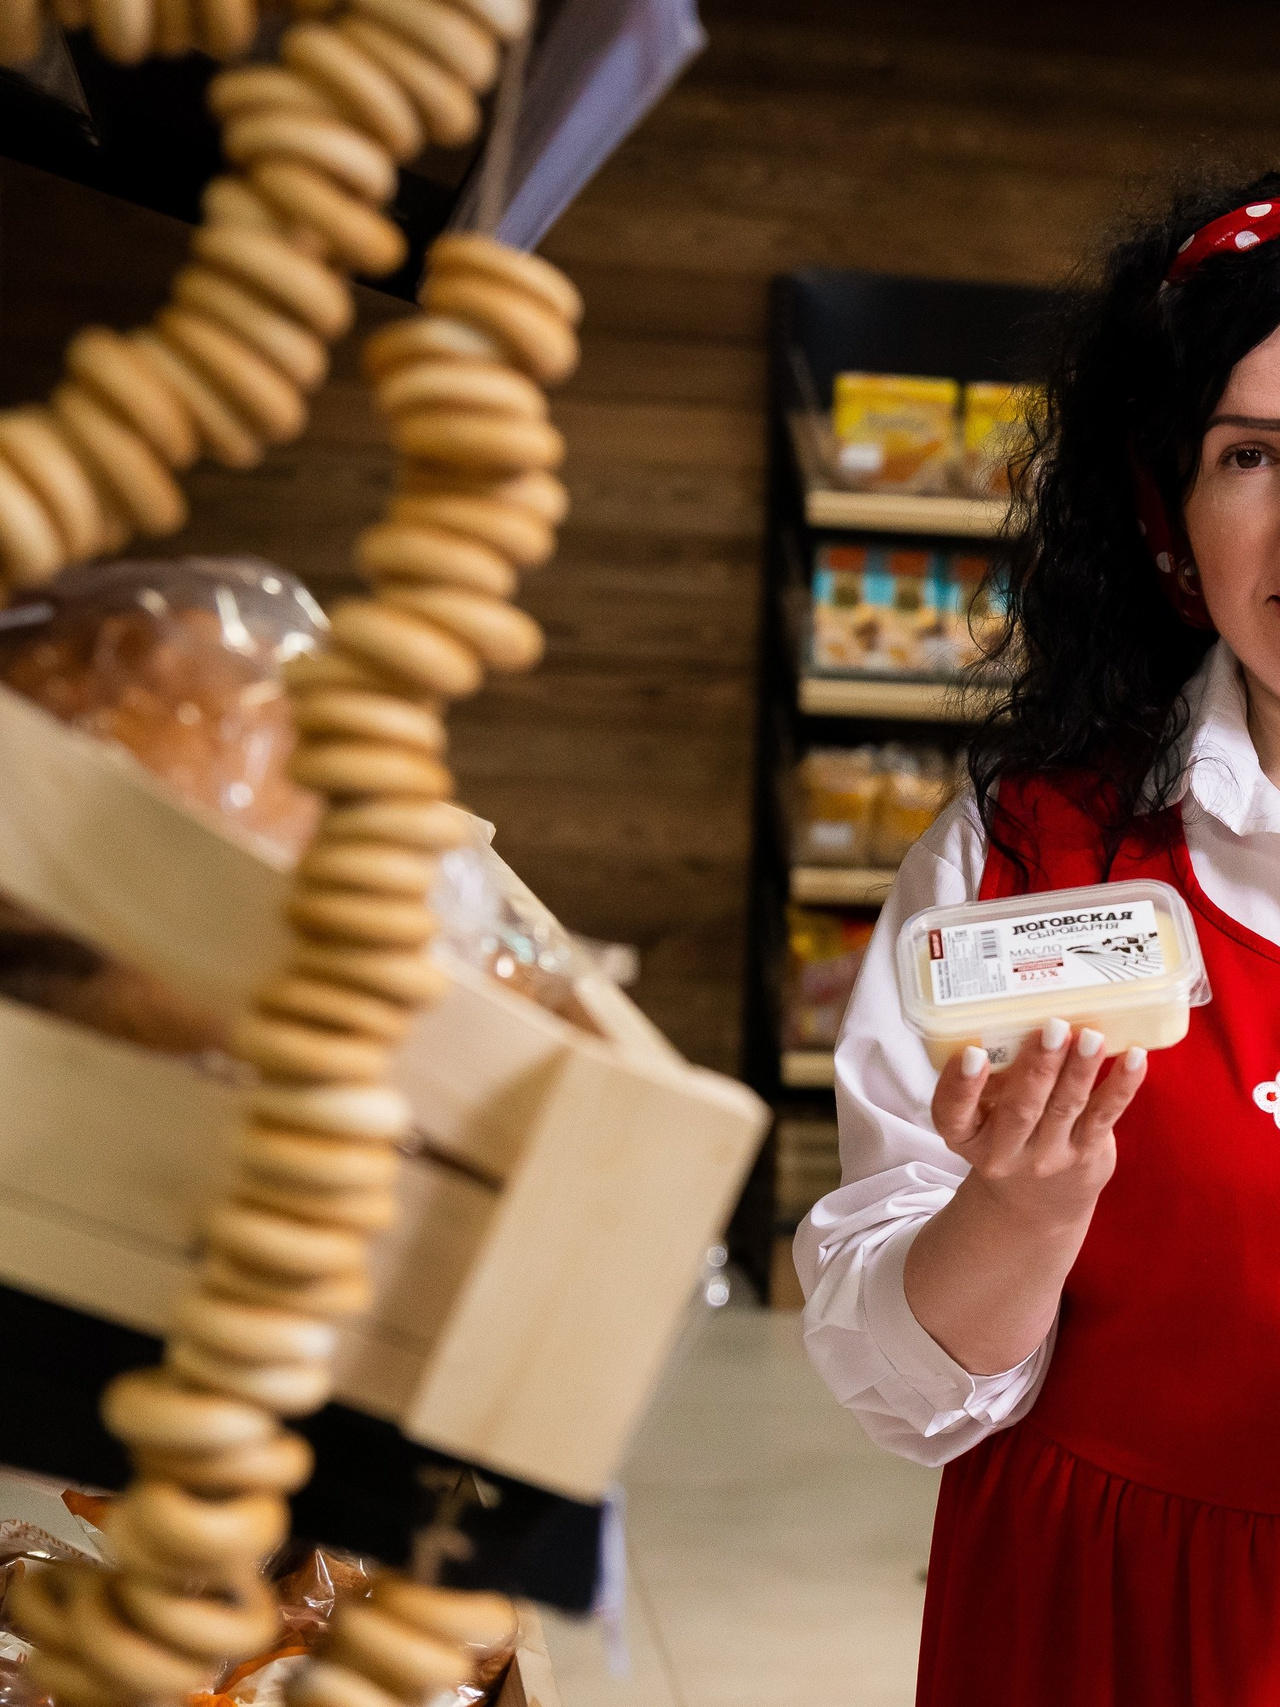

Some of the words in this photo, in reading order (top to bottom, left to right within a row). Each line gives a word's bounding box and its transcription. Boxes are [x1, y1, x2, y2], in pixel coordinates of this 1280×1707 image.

[1012, 911, 1134, 935] ЛОГОВСКАЯ
[1027, 922, 1119, 940] СЫРОВАРНЯ
[1009, 943, 1062, 957] МАСЛО
